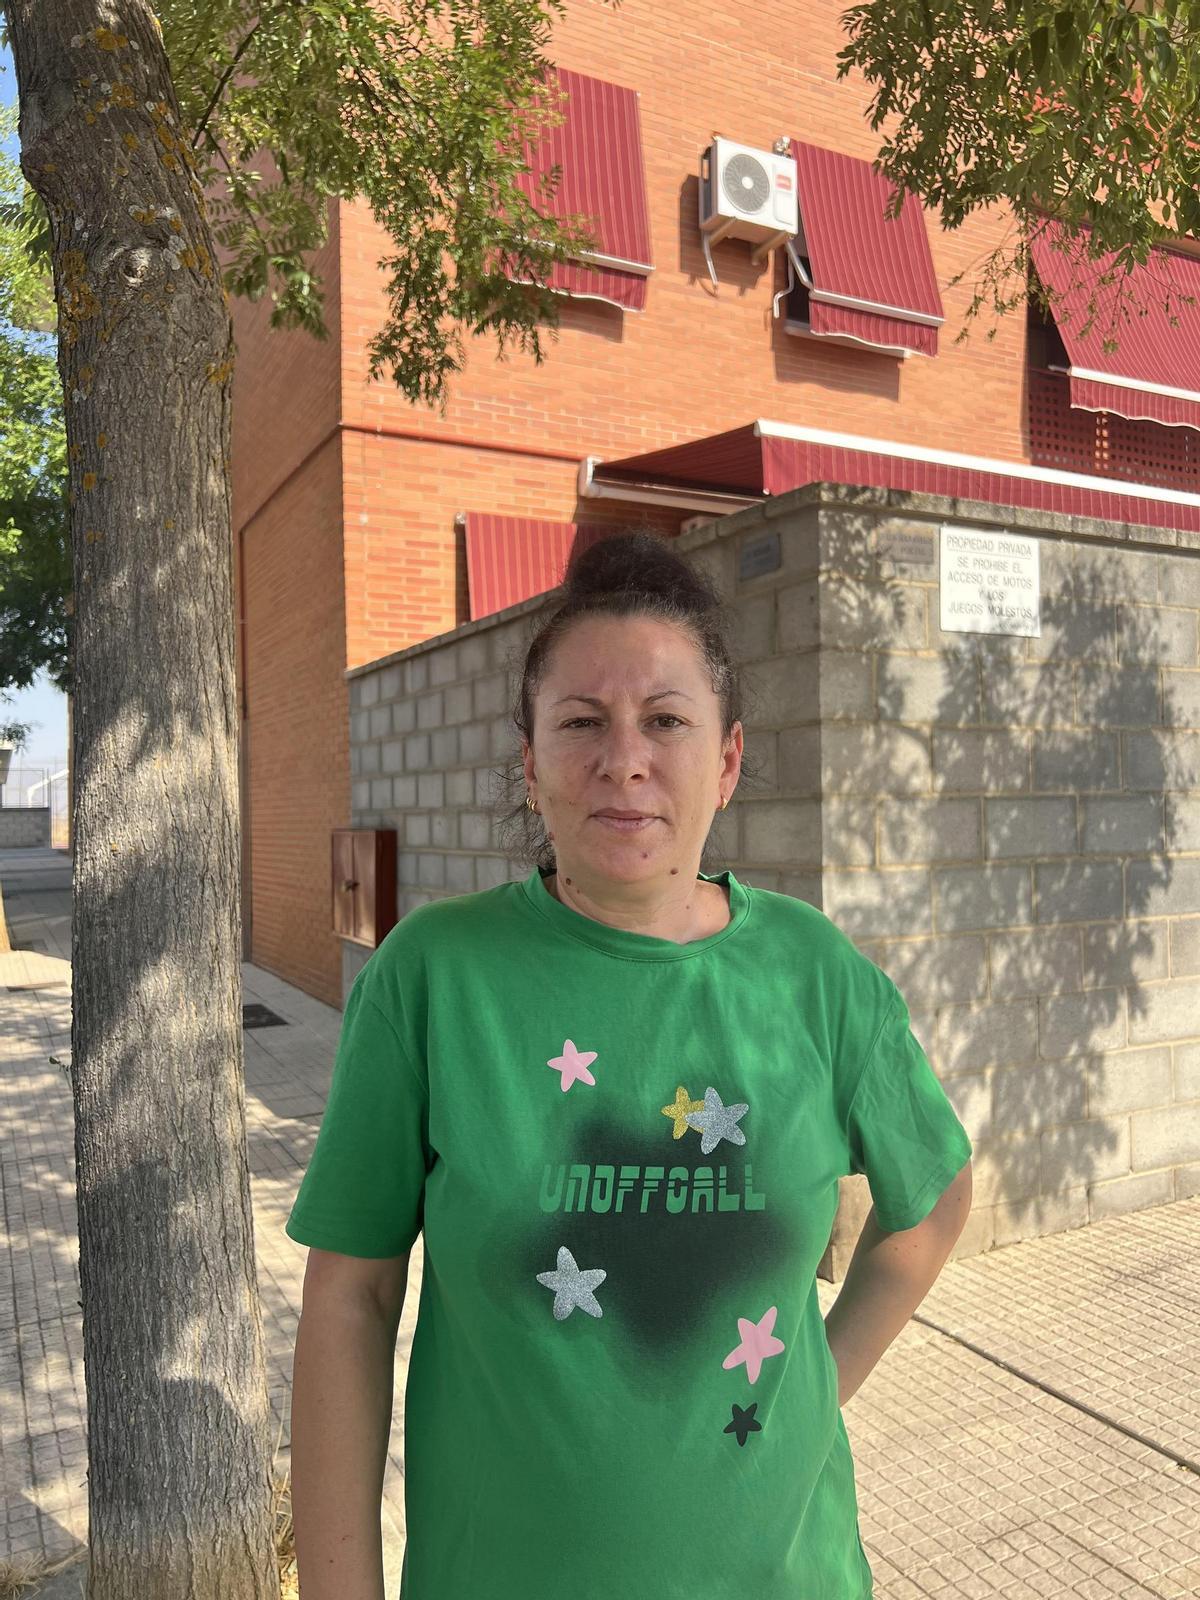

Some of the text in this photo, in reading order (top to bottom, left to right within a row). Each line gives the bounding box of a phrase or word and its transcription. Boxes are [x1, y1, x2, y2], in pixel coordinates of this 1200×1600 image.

[946, 535, 995, 552] PROPIEDAD
[998, 541, 1032, 557] PRIVADA
[957, 556, 1024, 574] SE PROHIBE EL
[947, 571, 1033, 590] ACCESO DE MOTOS
[948, 601, 1033, 618] JUEGOS MOLESTOS
